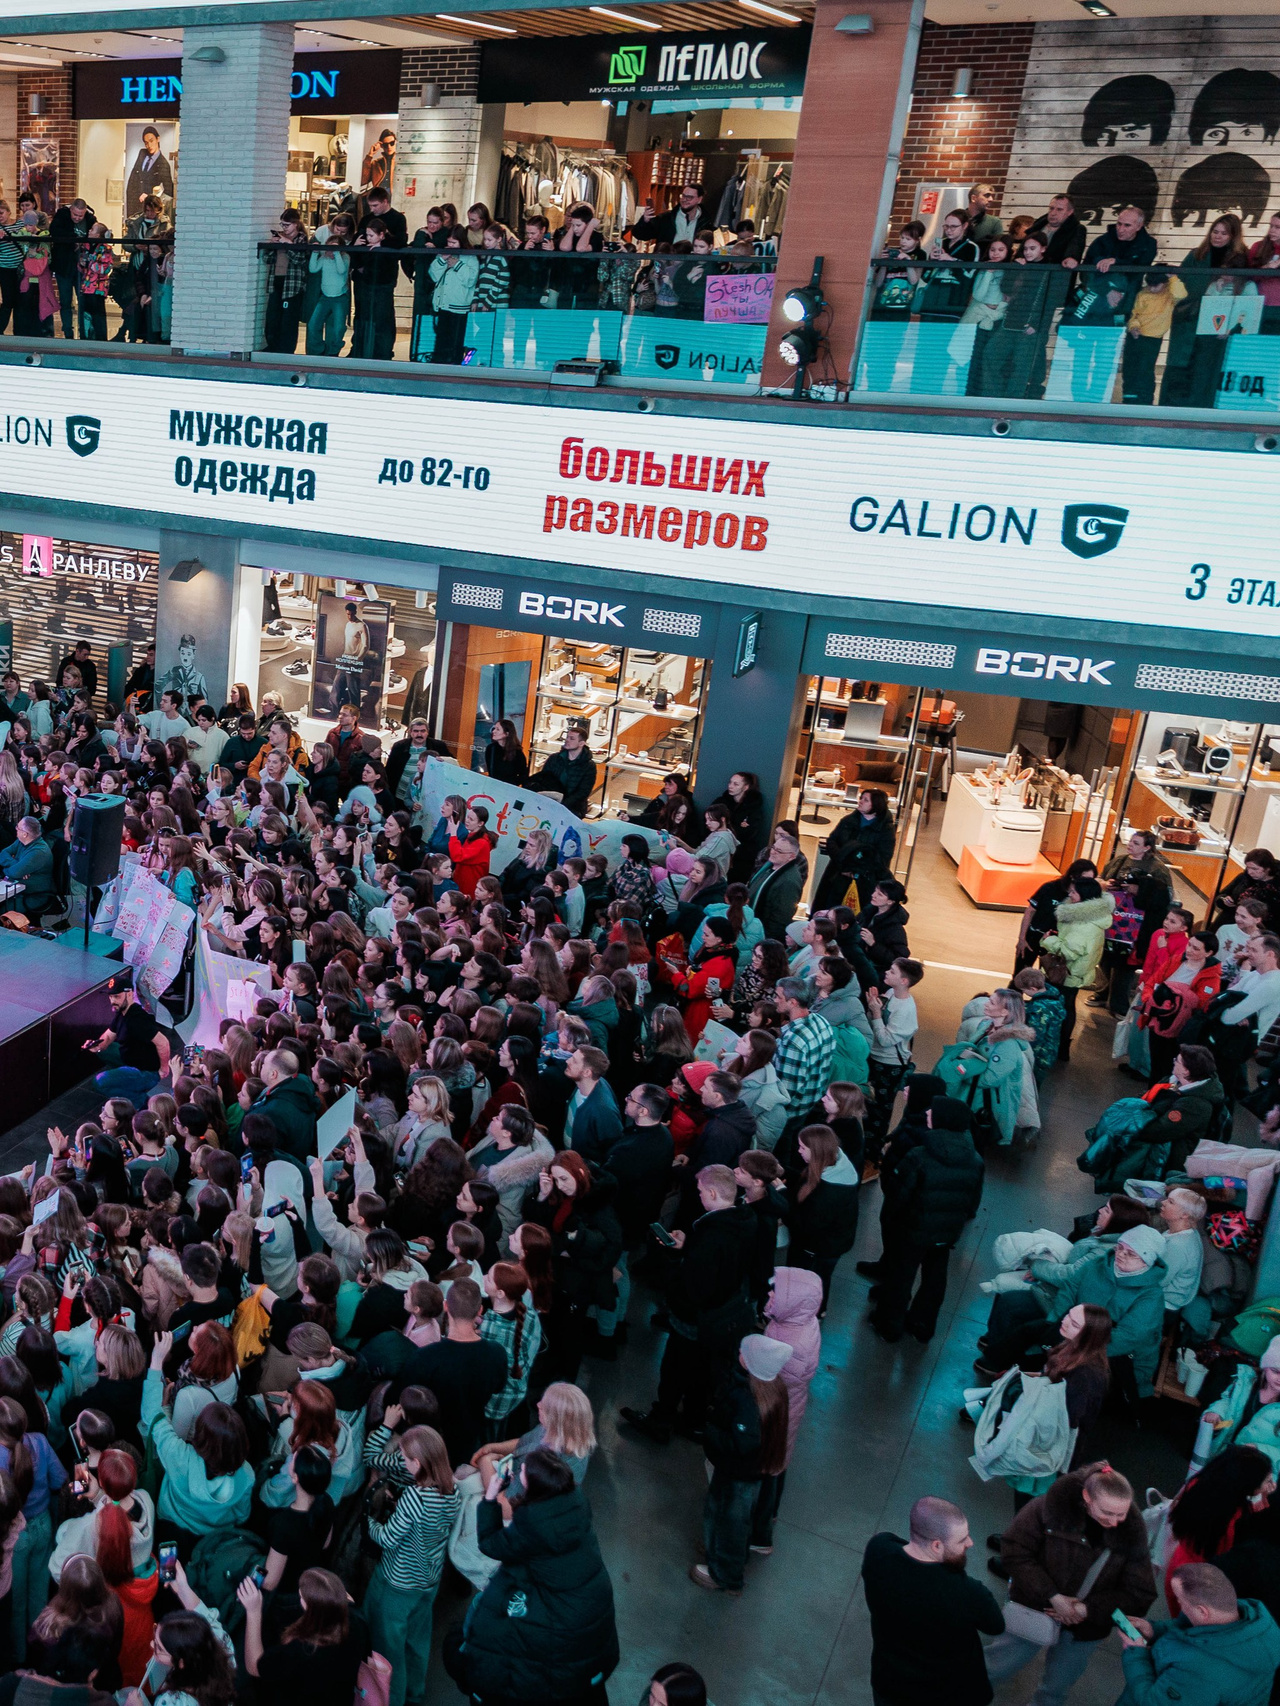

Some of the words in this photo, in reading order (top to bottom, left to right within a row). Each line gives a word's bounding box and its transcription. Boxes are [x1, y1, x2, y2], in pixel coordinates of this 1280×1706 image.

[657, 41, 768, 82] ПЕПЛОС
[690, 83, 744, 91] ШКОЛЬНАЯ
[174, 455, 316, 504] одежда
[378, 458, 414, 486] до
[420, 457, 490, 491] 82-го
[559, 436, 770, 497] больших
[543, 495, 769, 552] размеров
[849, 496, 1037, 545] GALION
[52, 553, 150, 582] РАНДЕВУ
[1184, 562, 1211, 601] 3
[1226, 577, 1280, 607] ЭТА
[519, 591, 627, 627] BORK
[975, 647, 1116, 685] BORK
[1113, 910, 1144, 920] berries
